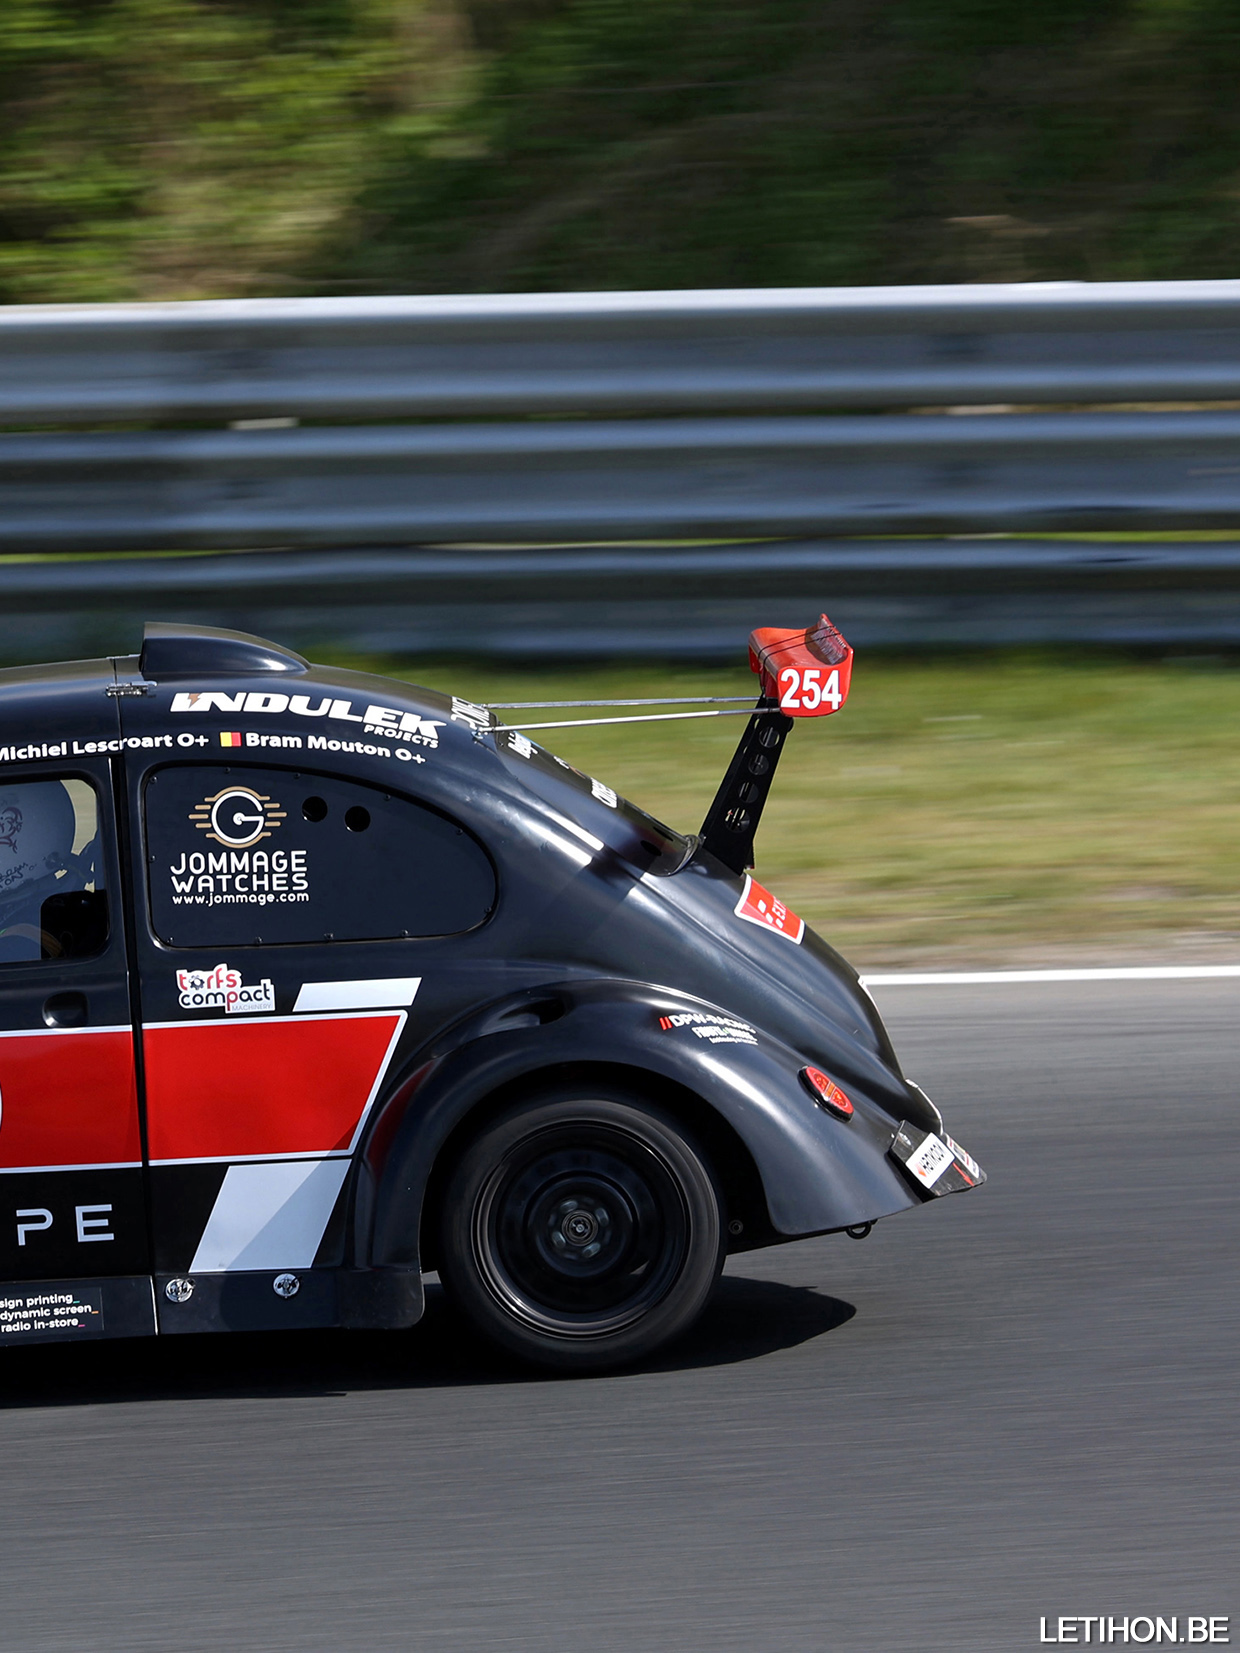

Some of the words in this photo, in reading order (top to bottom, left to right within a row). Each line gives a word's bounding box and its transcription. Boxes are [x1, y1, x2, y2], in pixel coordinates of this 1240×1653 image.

[780, 668, 843, 710] 254
[170, 692, 447, 738] INDULEK
[72, 732, 173, 756] Lescroart
[177, 733, 209, 748] O+
[245, 732, 303, 749] Bram
[308, 736, 391, 758] Mouton
[395, 748, 426, 764] O+
[364, 724, 439, 749] PROJECTS
[170, 850, 308, 875] JOMMAGE
[171, 873, 309, 893] WATCHES
[172, 892, 309, 907] www.jommage.com
[181, 983, 271, 1011] compact
[0, 1307, 50, 1321] dynamic
[0, 1321, 31, 1333] radio
